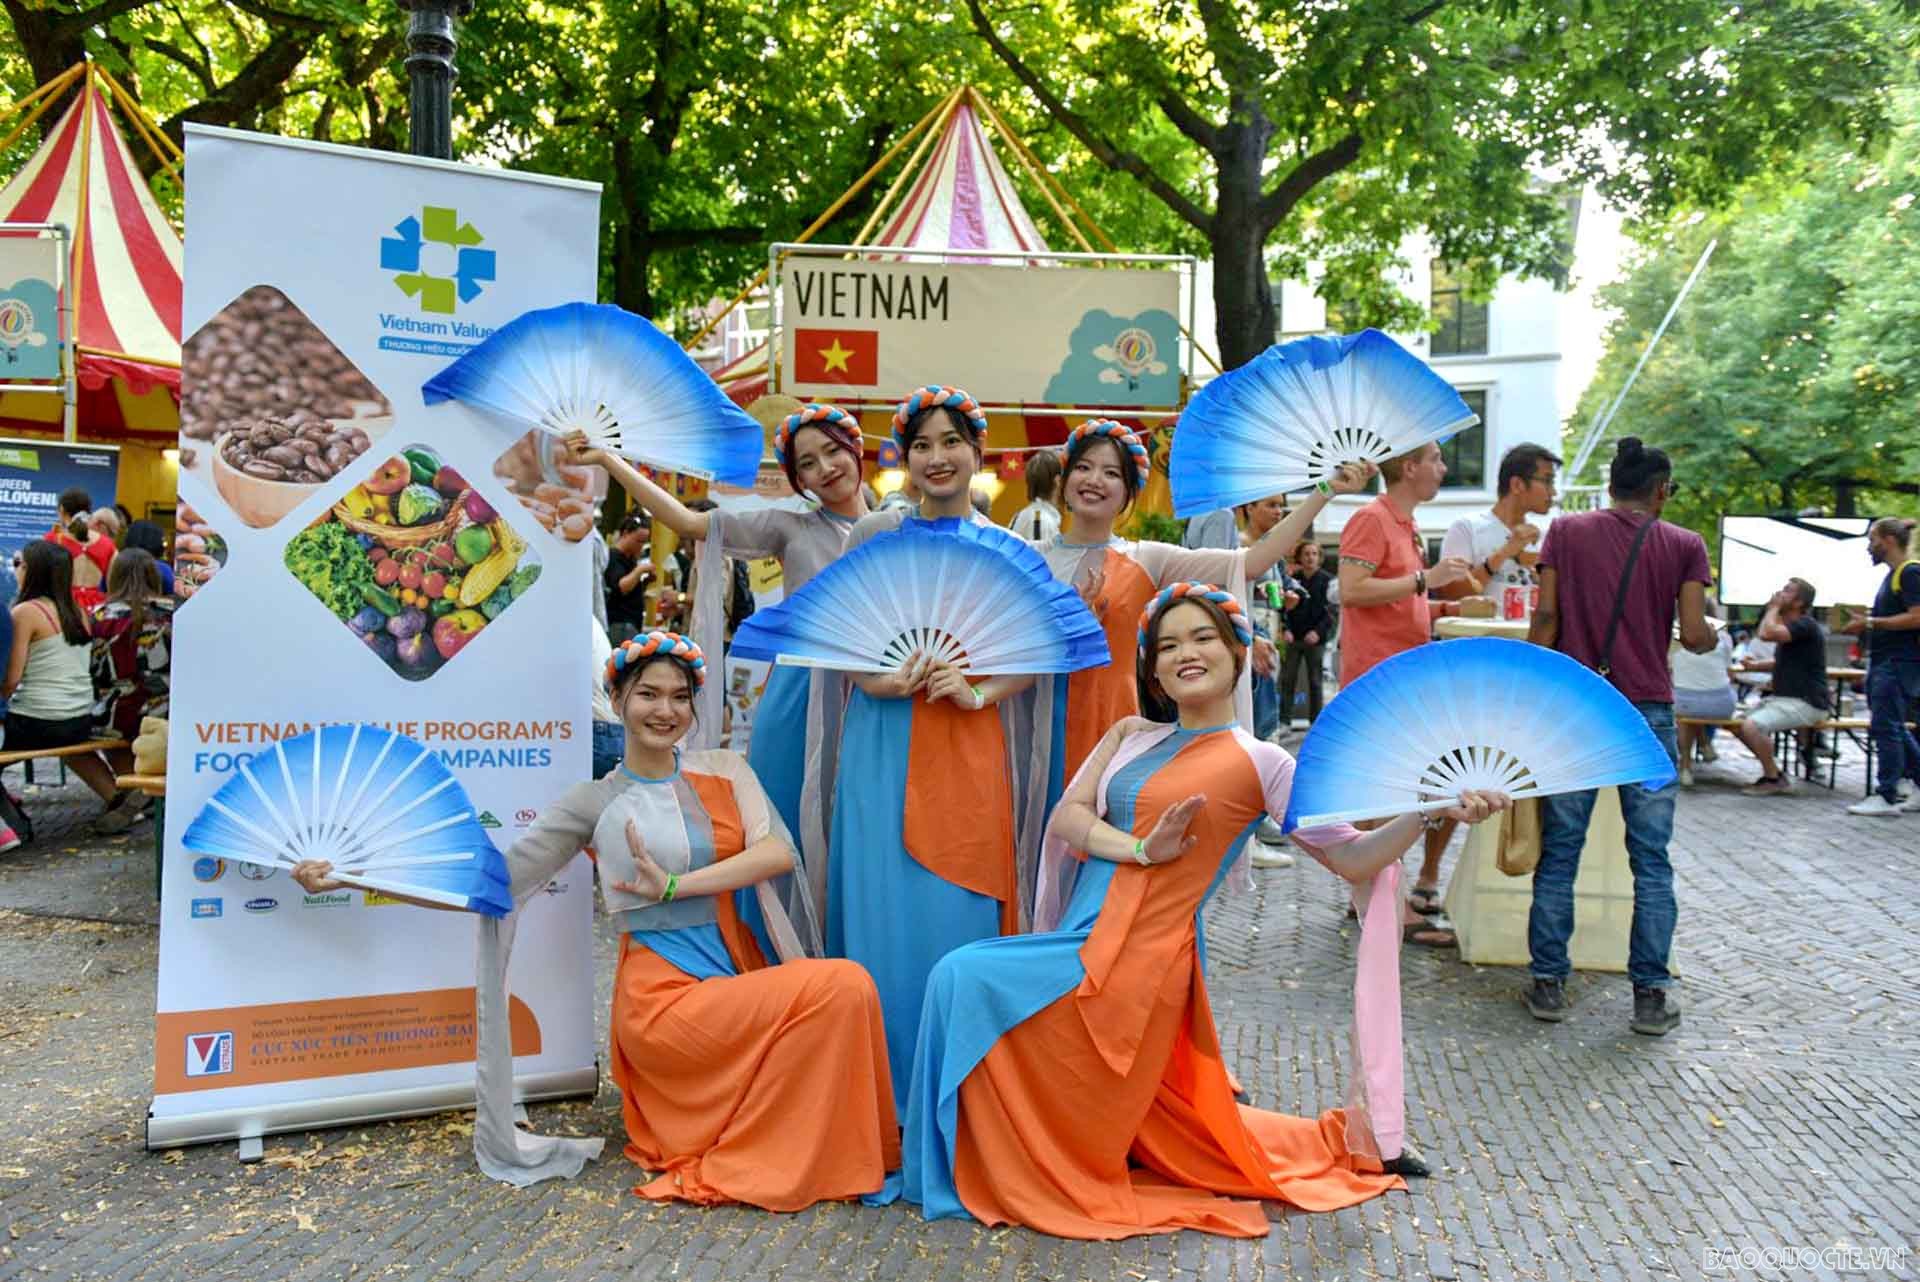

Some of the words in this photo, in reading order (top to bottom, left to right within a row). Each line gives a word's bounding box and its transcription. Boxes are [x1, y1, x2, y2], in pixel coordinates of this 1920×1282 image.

[793, 270, 949, 321] VIETNAM
[379, 313, 448, 336] Vietnam
[195, 752, 258, 773] FOO
